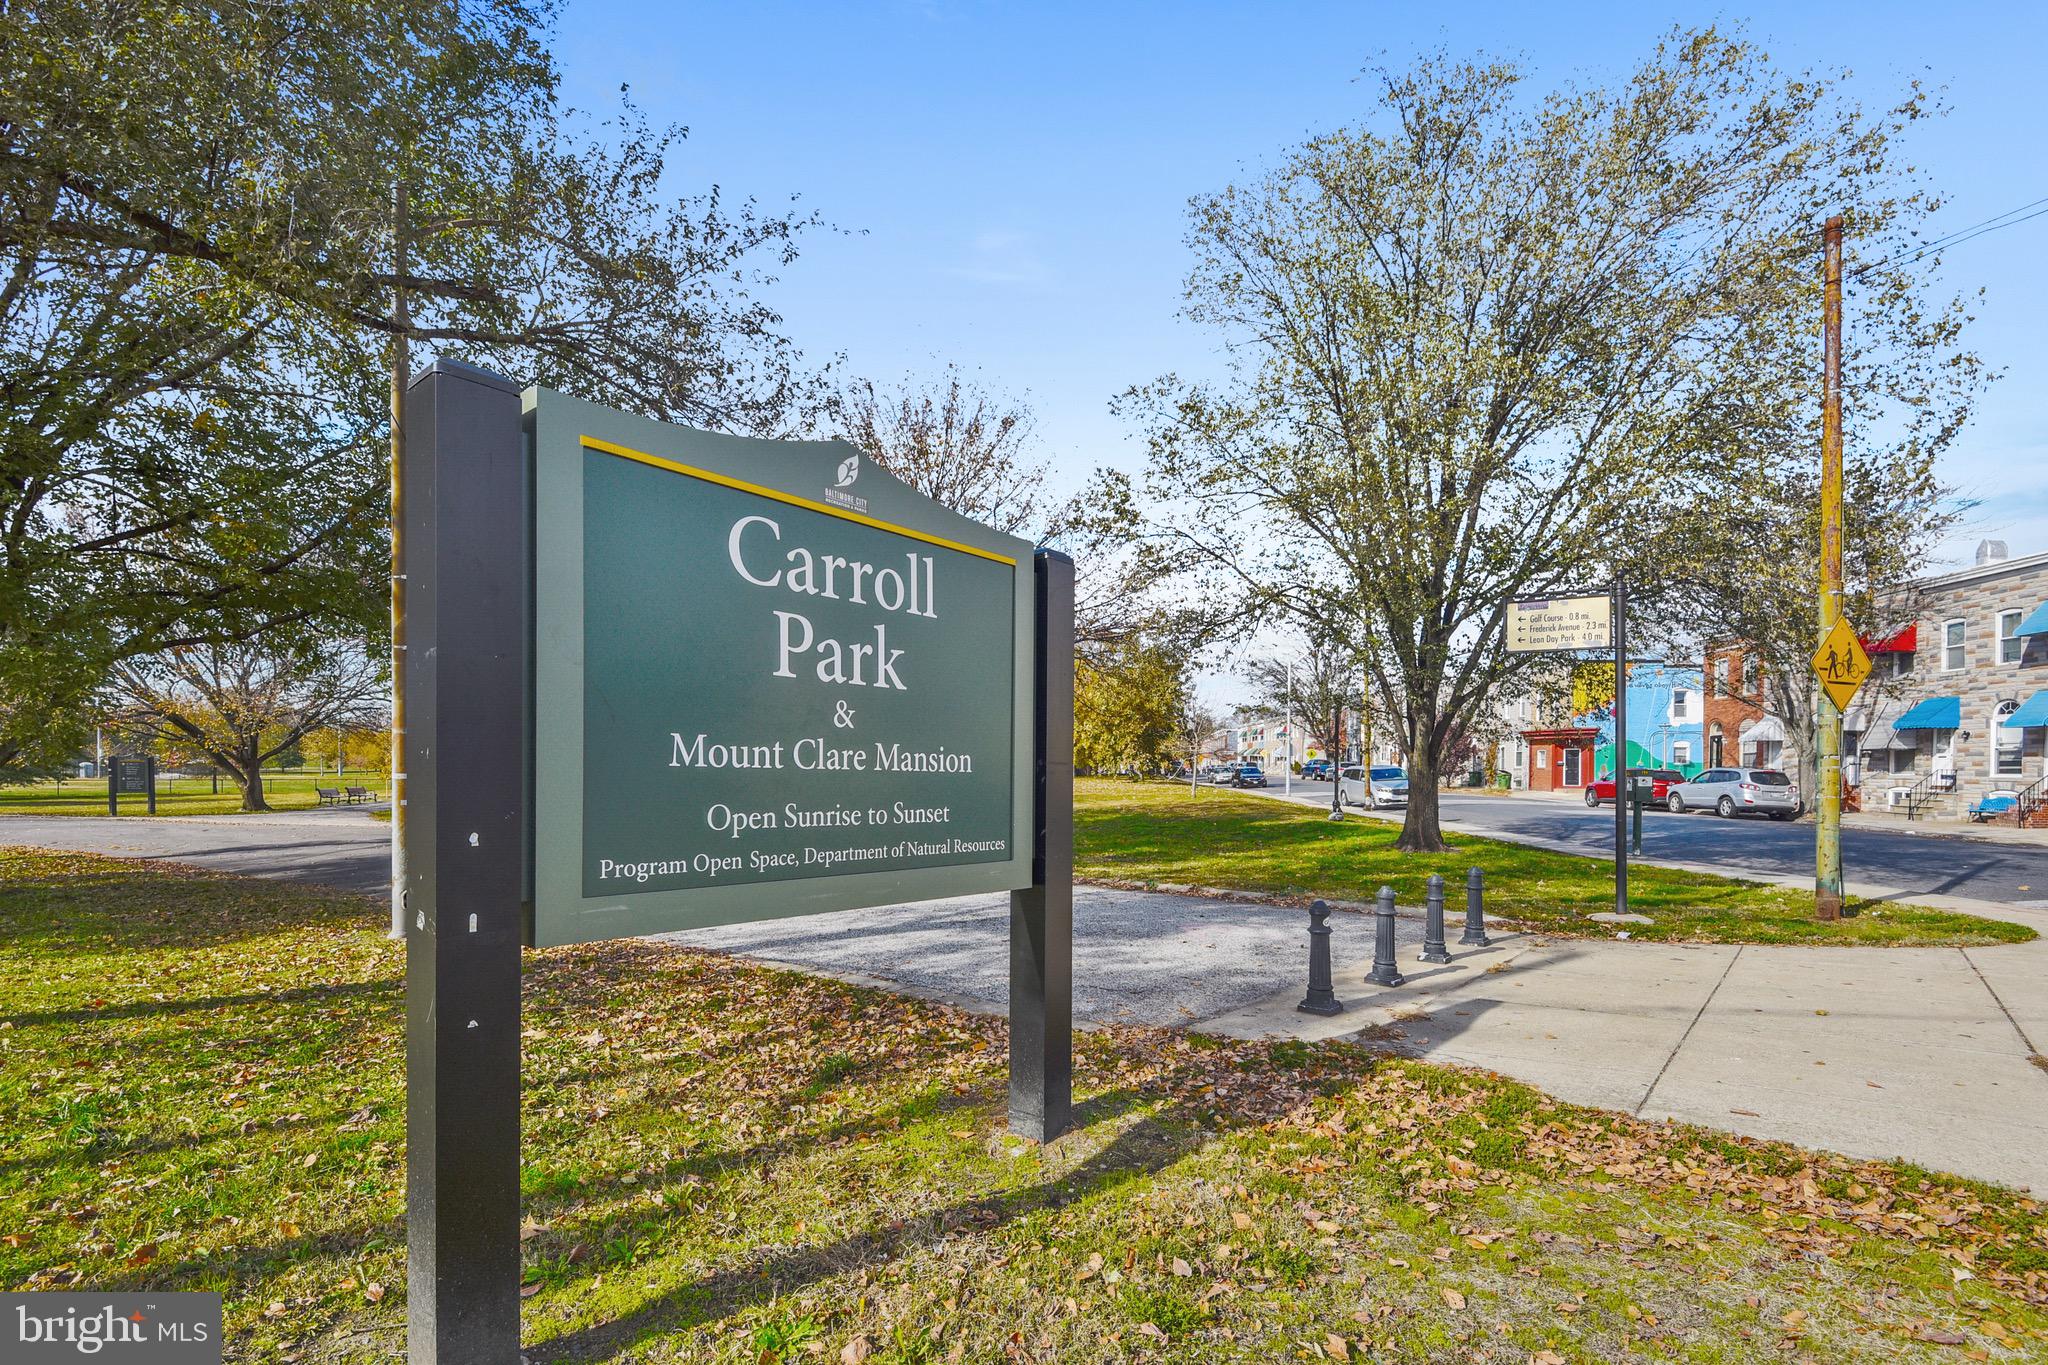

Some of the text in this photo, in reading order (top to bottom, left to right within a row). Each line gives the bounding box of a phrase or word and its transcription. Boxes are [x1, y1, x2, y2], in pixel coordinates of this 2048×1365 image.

[825, 487, 867, 507] BALTIMORE CITY
[728, 515, 938, 619] Carroll
[1529, 614, 1542, 623] Golf
[1543, 613, 1564, 622] Course
[1529, 623, 1556, 633] Frederick
[1557, 623, 1581, 632] Avenue
[772, 610, 907, 691] Park
[1529, 636, 1545, 644] Leon
[1546, 634, 1559, 645] Day
[1560, 633, 1576, 642] Park
[833, 699, 856, 729] &
[668, 732, 973, 773] Mount Clare Mansion
[706, 801, 950, 838] Open Sunrise to Sunset
[599, 837, 1006, 883] Program Open Space, Department of Natural Resources
